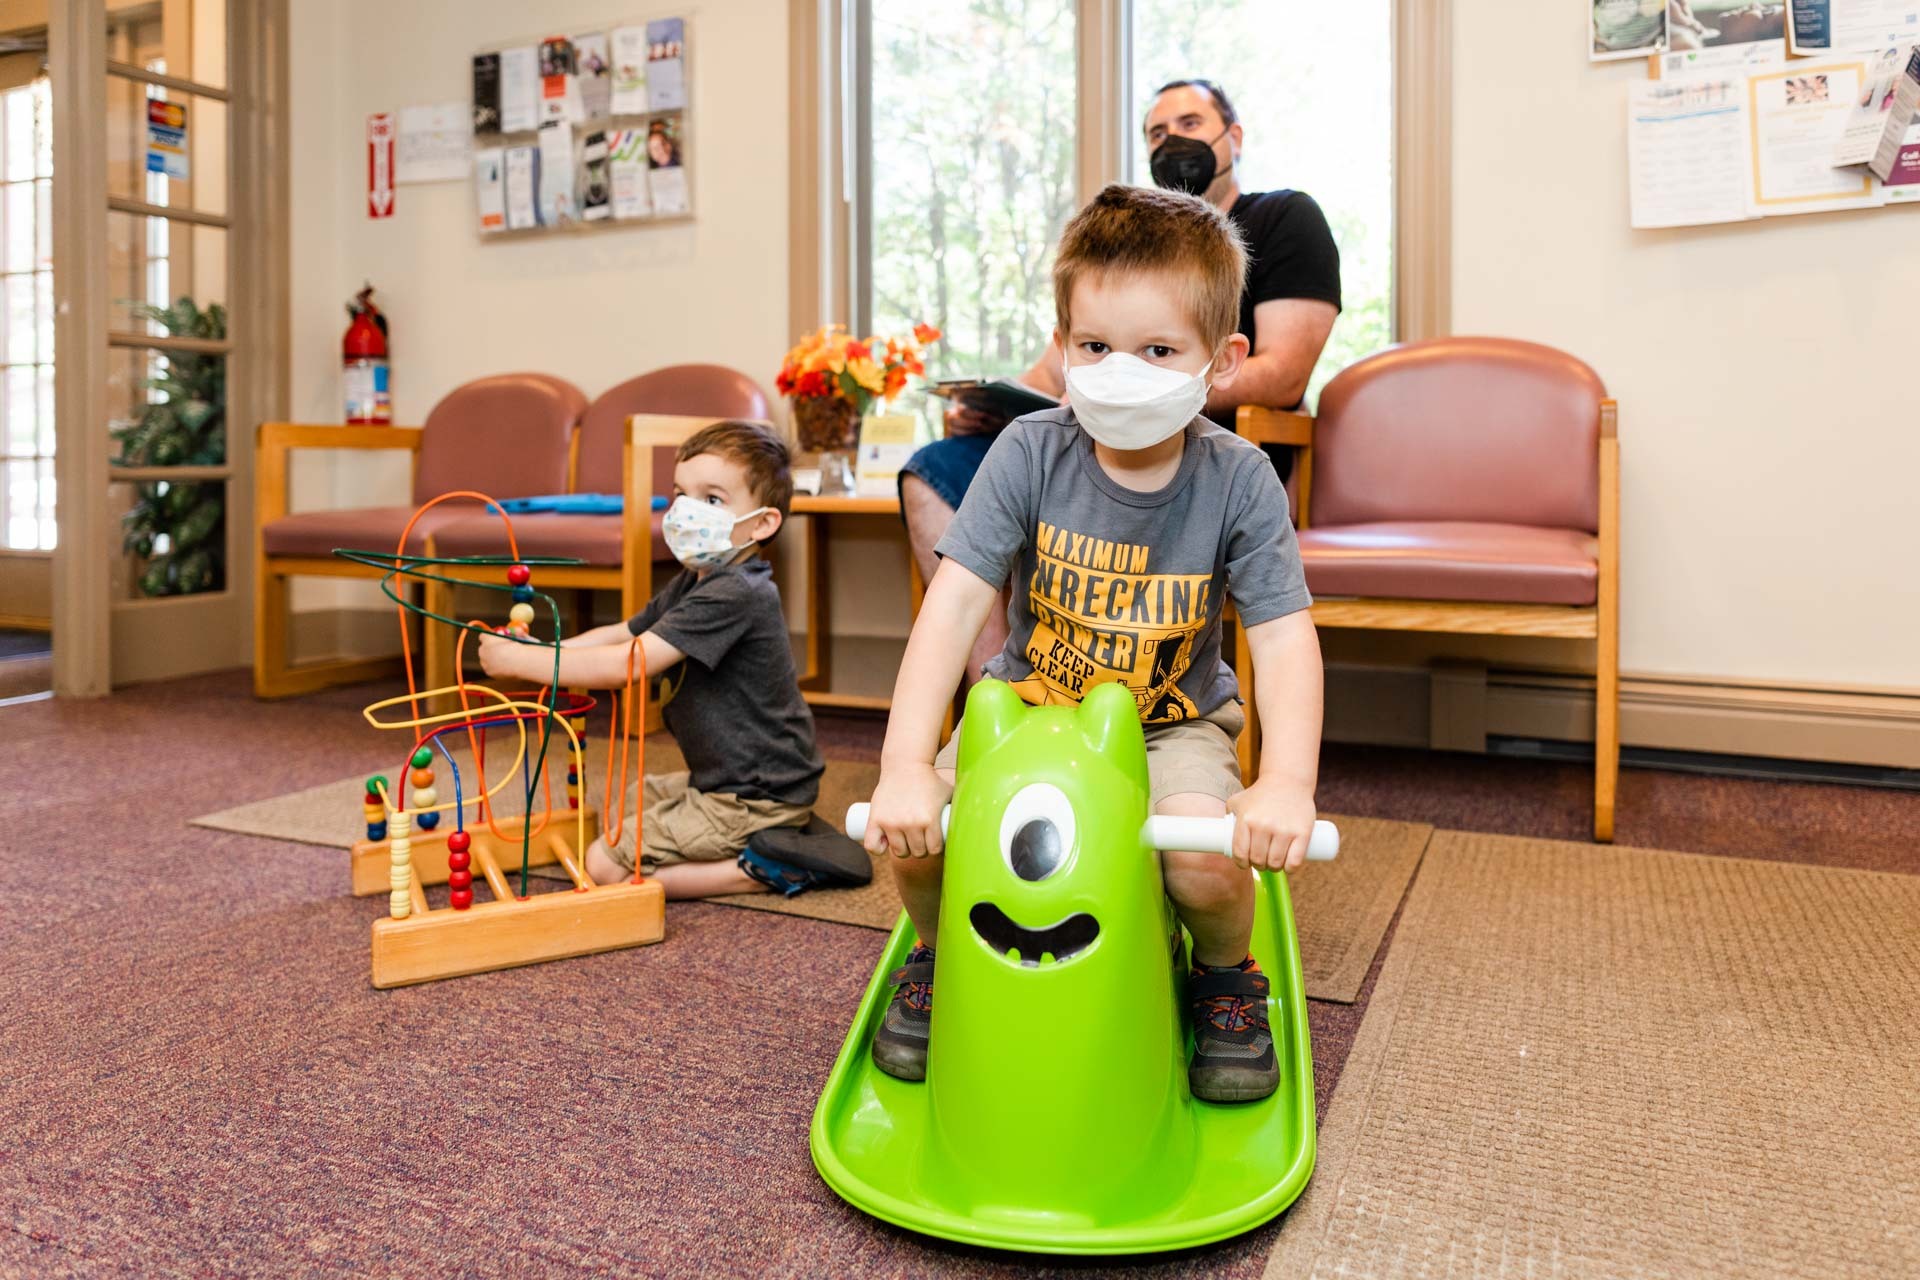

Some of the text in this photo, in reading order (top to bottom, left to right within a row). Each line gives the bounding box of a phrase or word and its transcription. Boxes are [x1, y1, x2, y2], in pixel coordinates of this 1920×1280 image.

[1037, 521, 1149, 574] MAXIMUM
[1028, 647, 1084, 694] CLEAR
[1049, 639, 1094, 679] KEEP
